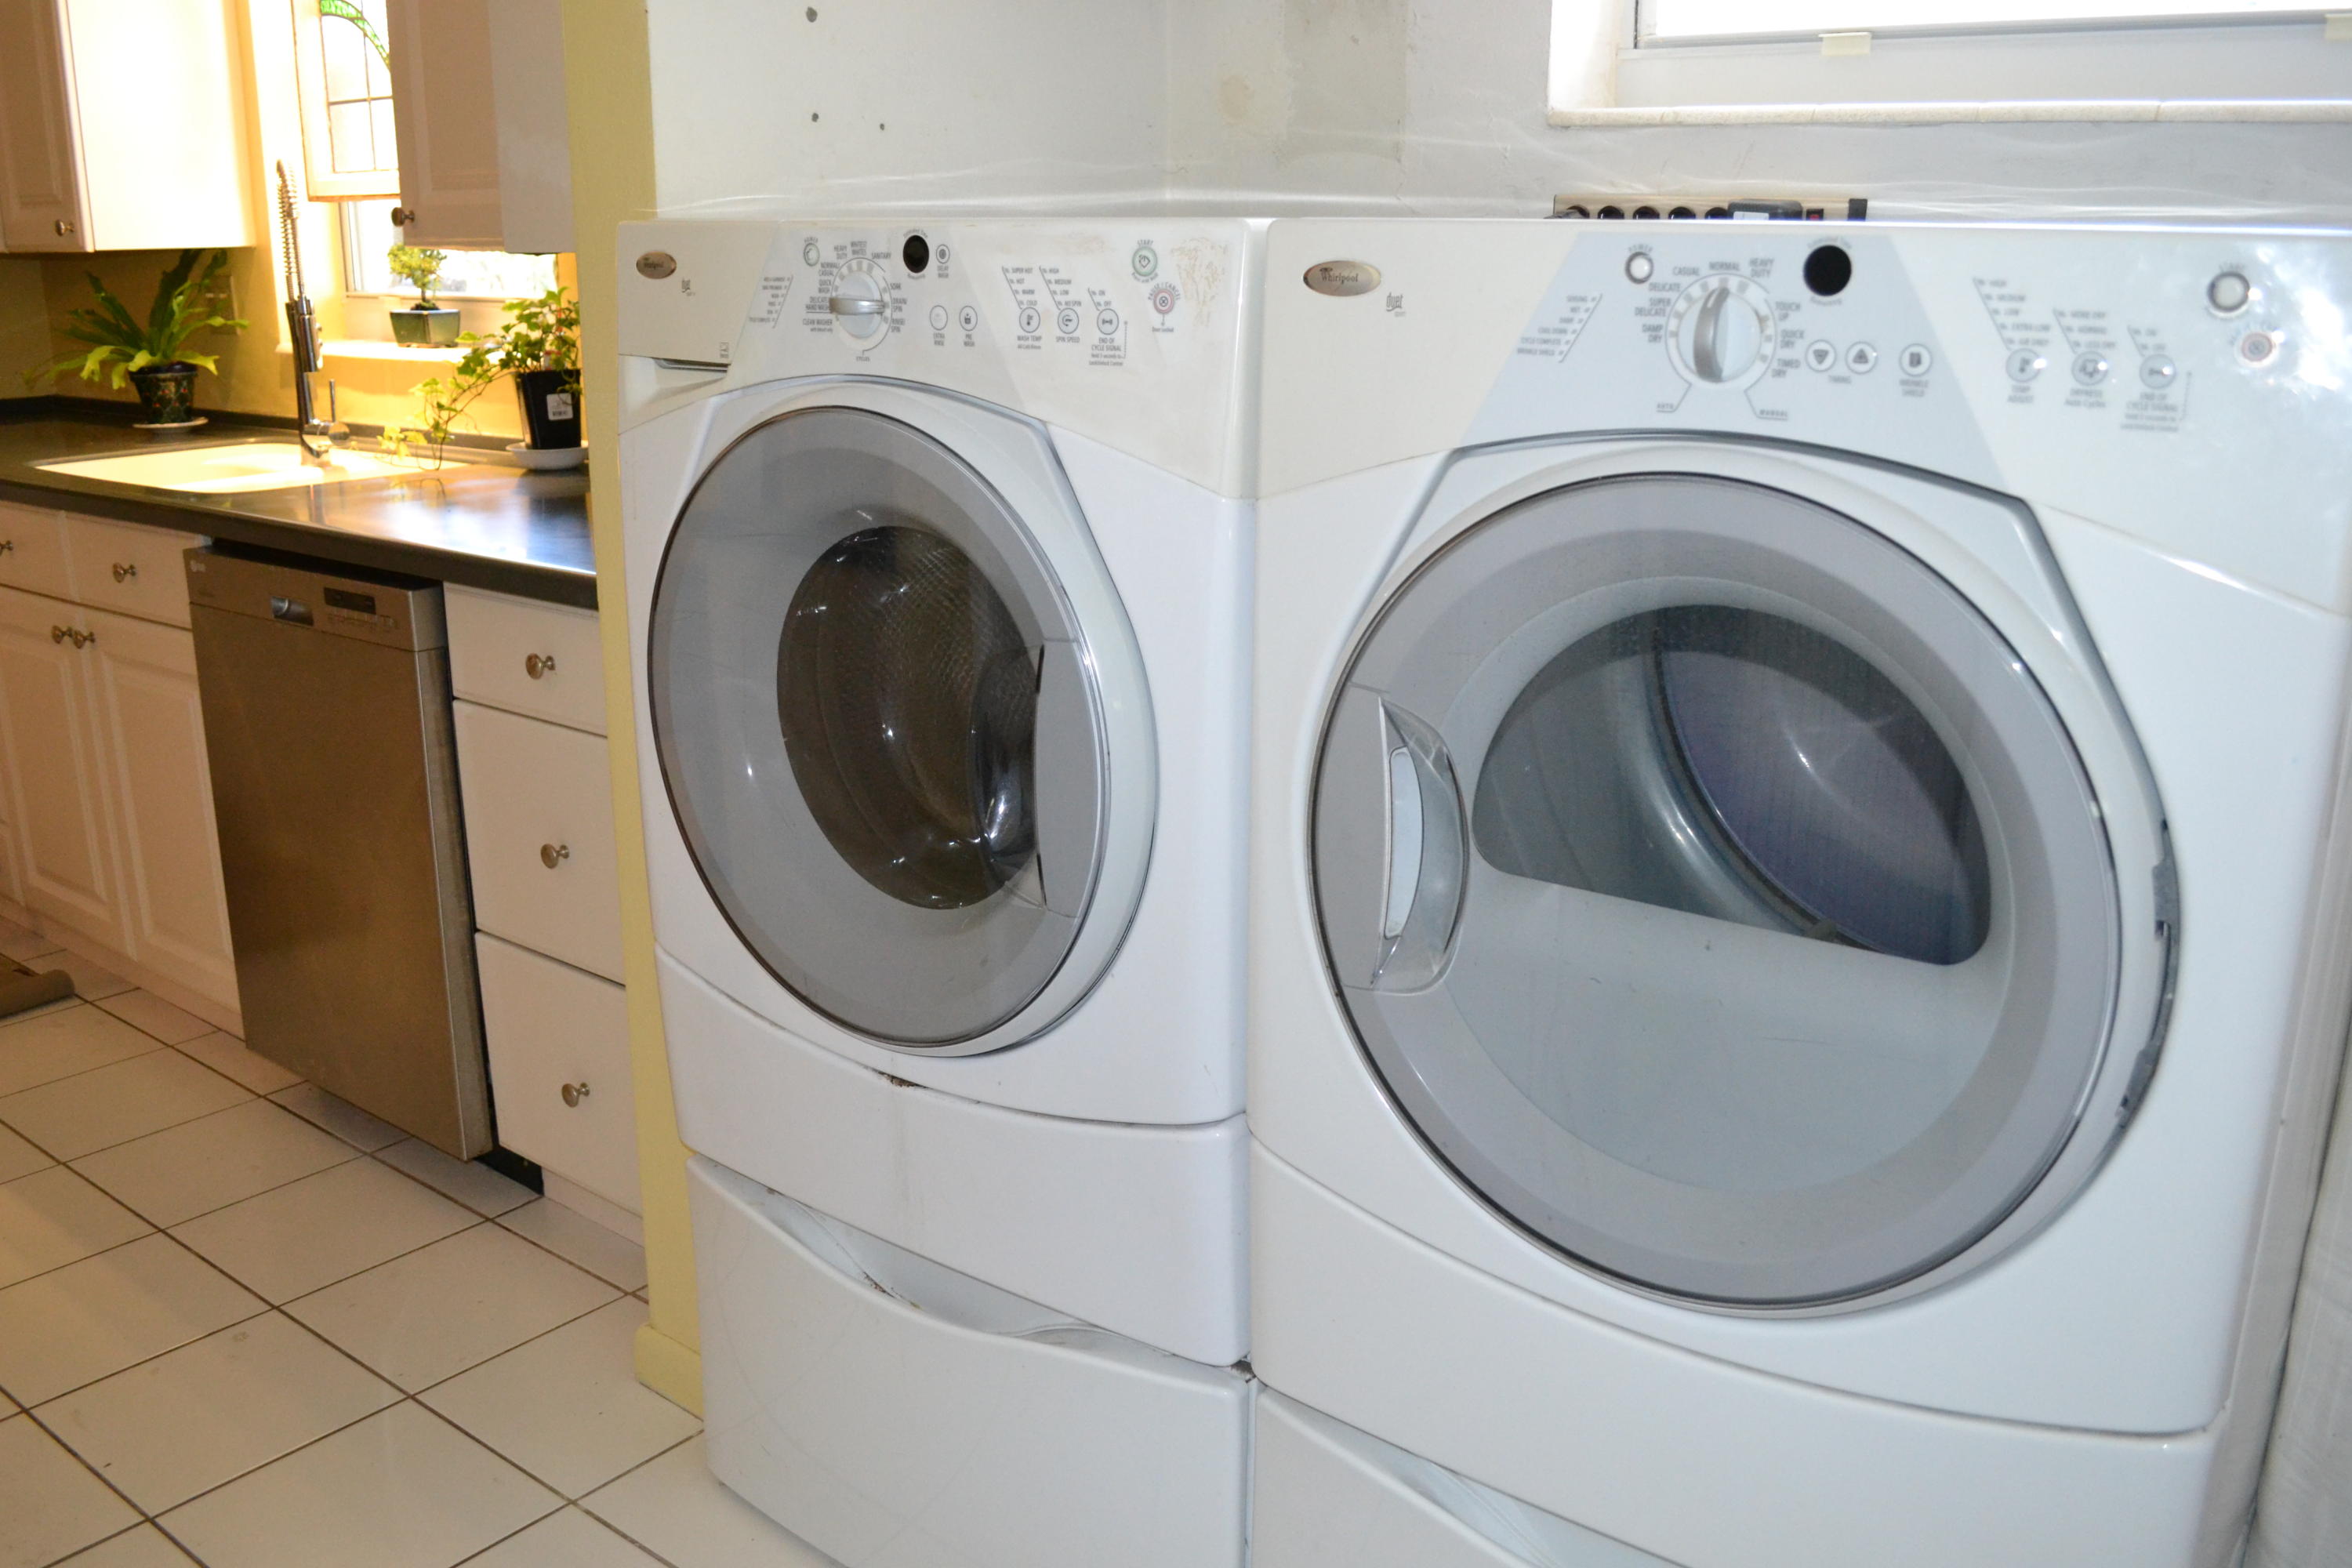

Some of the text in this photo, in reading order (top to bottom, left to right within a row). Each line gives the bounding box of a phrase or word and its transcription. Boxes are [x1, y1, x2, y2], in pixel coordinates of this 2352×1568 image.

[1708, 261, 1740, 271] NORMAL
[1748, 257, 1775, 267] HEAVY
[1672, 266, 1700, 276] CASUAL
[1750, 268, 1771, 278] DUTY
[1320, 273, 1359, 285] Whirlpool
[1648, 281, 1681, 292] DELICATE
[1649, 297, 1671, 307] SUPER
[1774, 301, 1802, 312] TOUCH
[1635, 307, 1667, 317] DELICATE
[1779, 312, 1789, 321] UP
[1642, 324, 1664, 333] DAMP
[1781, 328, 1805, 339] QUICK
[1648, 333, 1663, 343] DRY
[1780, 339, 1795, 349] DRY
[1777, 358, 1802, 368] TIMED
[1771, 368, 1788, 379] DRY
